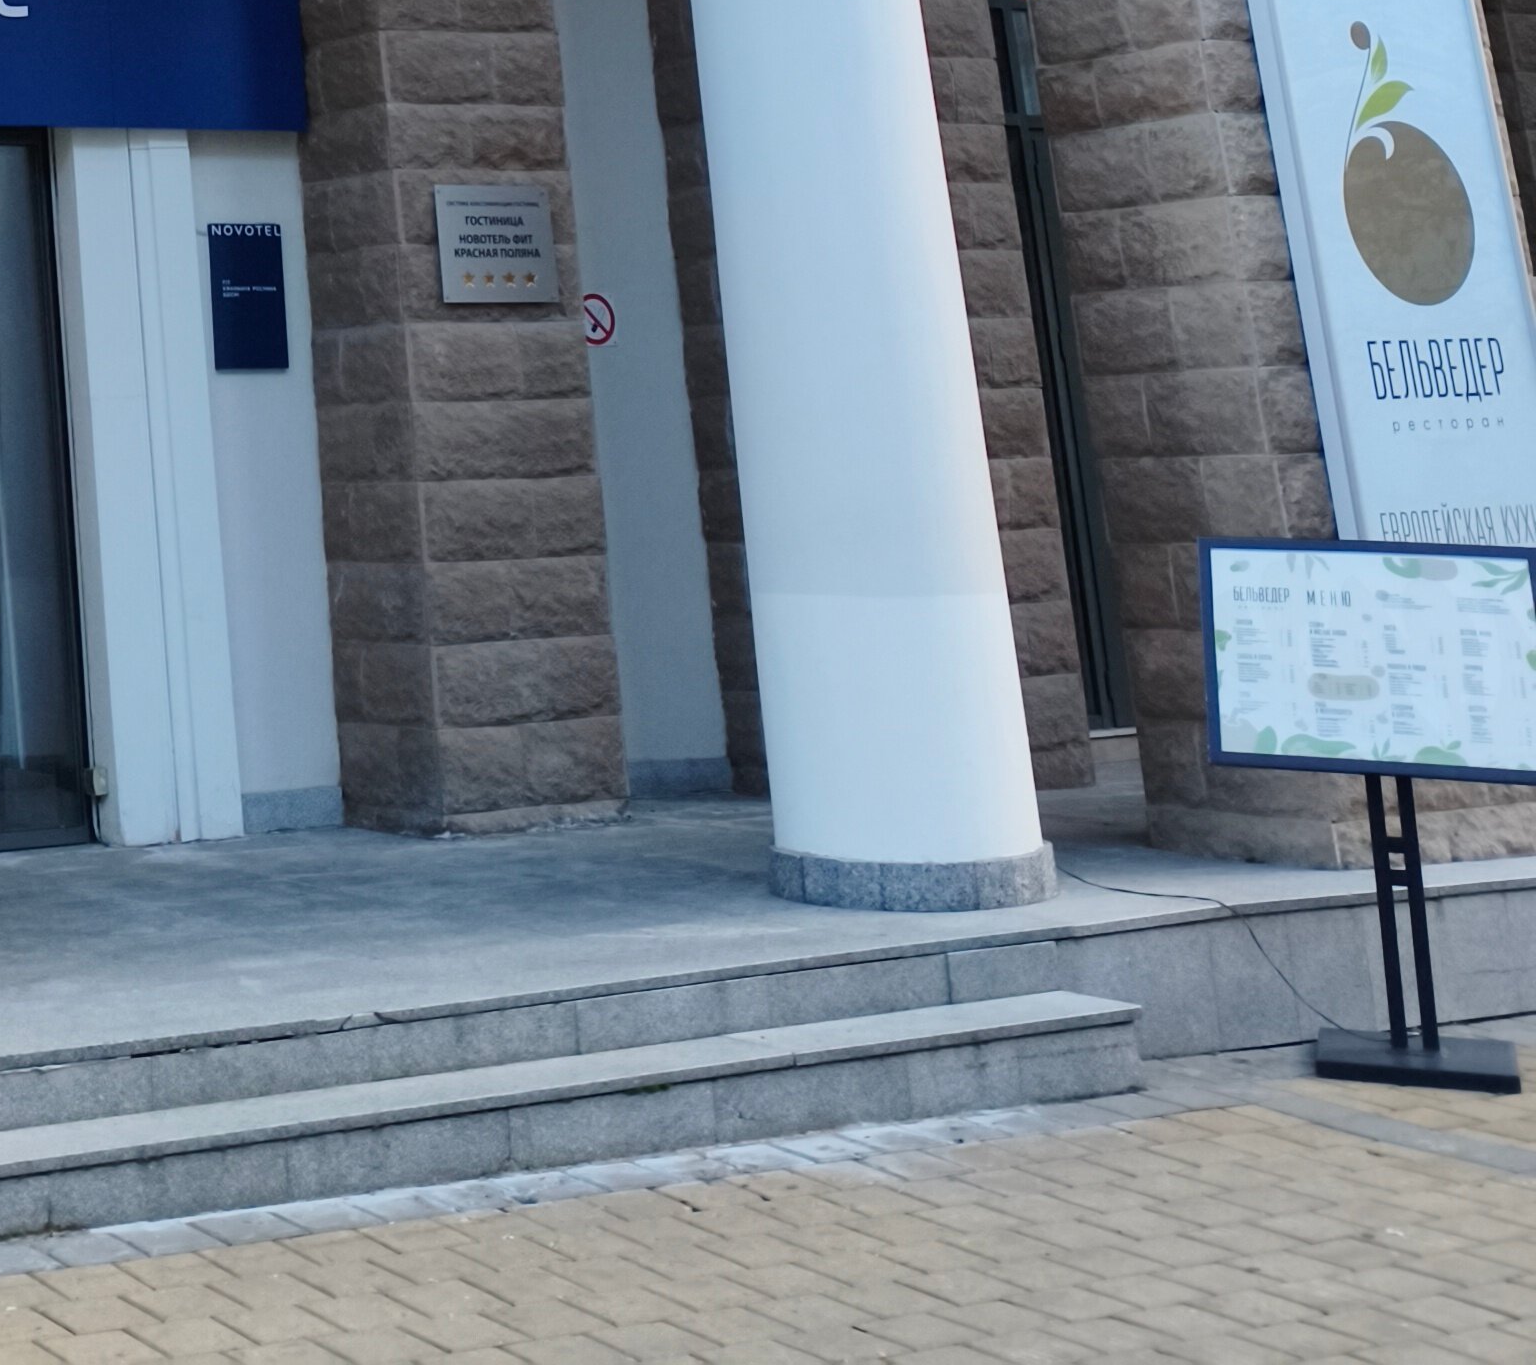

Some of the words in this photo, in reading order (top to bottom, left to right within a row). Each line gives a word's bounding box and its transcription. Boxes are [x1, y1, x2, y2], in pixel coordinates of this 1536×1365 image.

[464, 215, 525, 227] ГОСТИНИЦА
[211, 224, 281, 237] NOVOTEL
[458, 234, 511, 244] НОВОТЕЛЬ
[512, 234, 533, 244] ФИТ
[454, 248, 499, 258] КРАСНАЯ
[500, 248, 541, 258] ПОЛЯНА
[1366, 337, 1505, 403] БЕЛЬВЕДЕР
[1392, 416, 1505, 434] ресторан
[1379, 503, 1498, 544] ЕВРОПЕЙСКАЯ
[1232, 585, 1290, 604] БЕЛЬВЕДЕР
[1306, 589, 1352, 607] МЕНЮ
